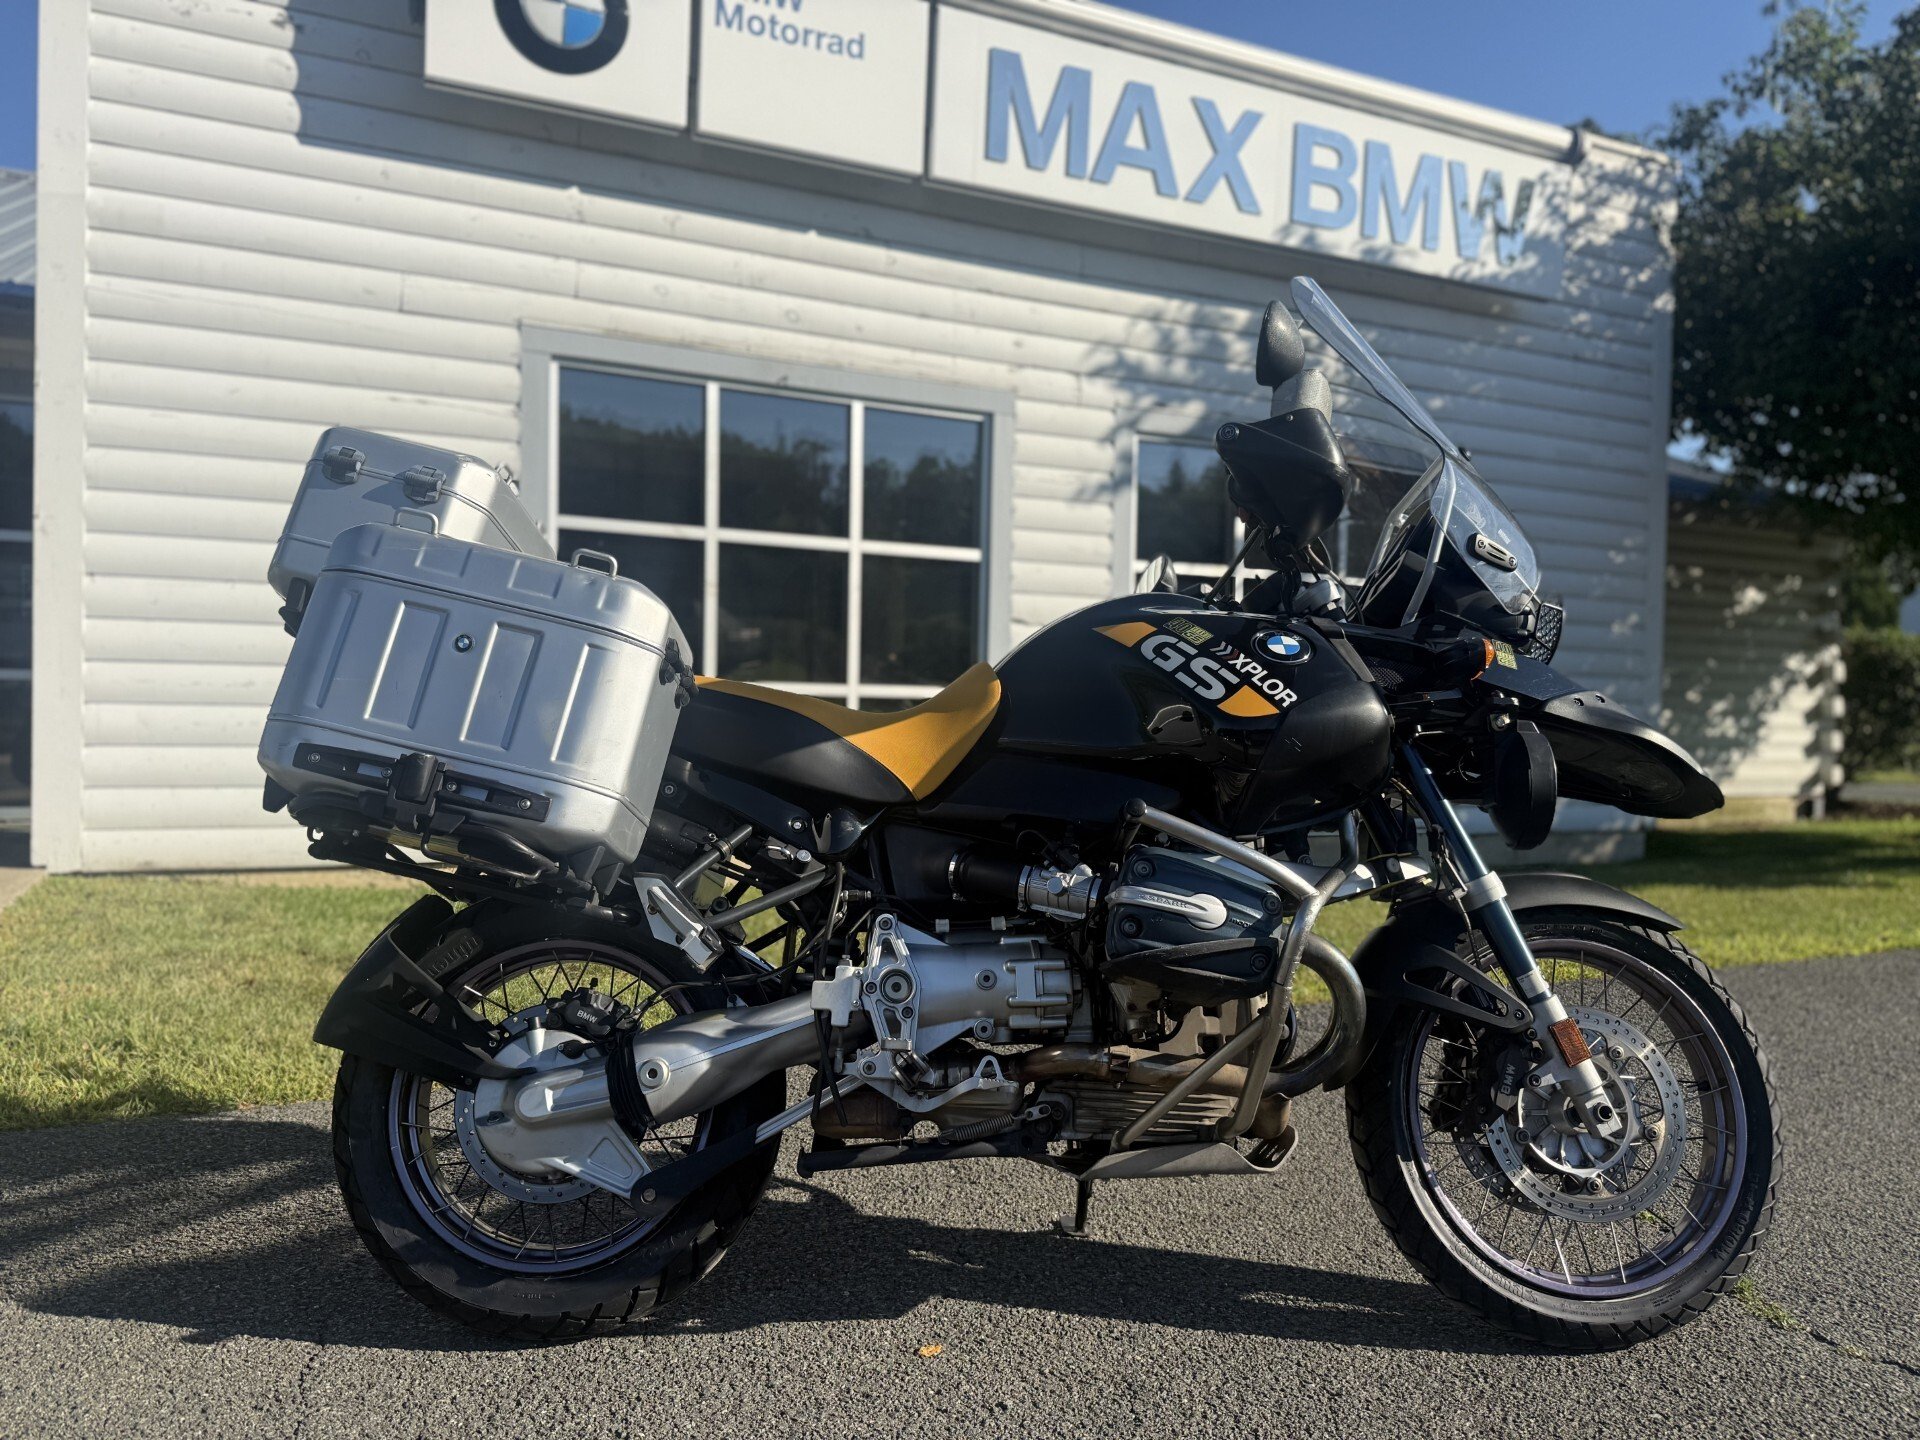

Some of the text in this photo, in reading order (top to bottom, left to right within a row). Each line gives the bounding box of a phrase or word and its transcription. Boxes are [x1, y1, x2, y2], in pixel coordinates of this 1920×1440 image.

[715, 0, 865, 59] Motorrad
[984, 46, 1536, 268] MAX BMW
[1140, 634, 1241, 700] GS
[1228, 652, 1298, 708] XPLOR
[577, 1010, 598, 1023] BMW
[1501, 1063, 1516, 1095] BMW
